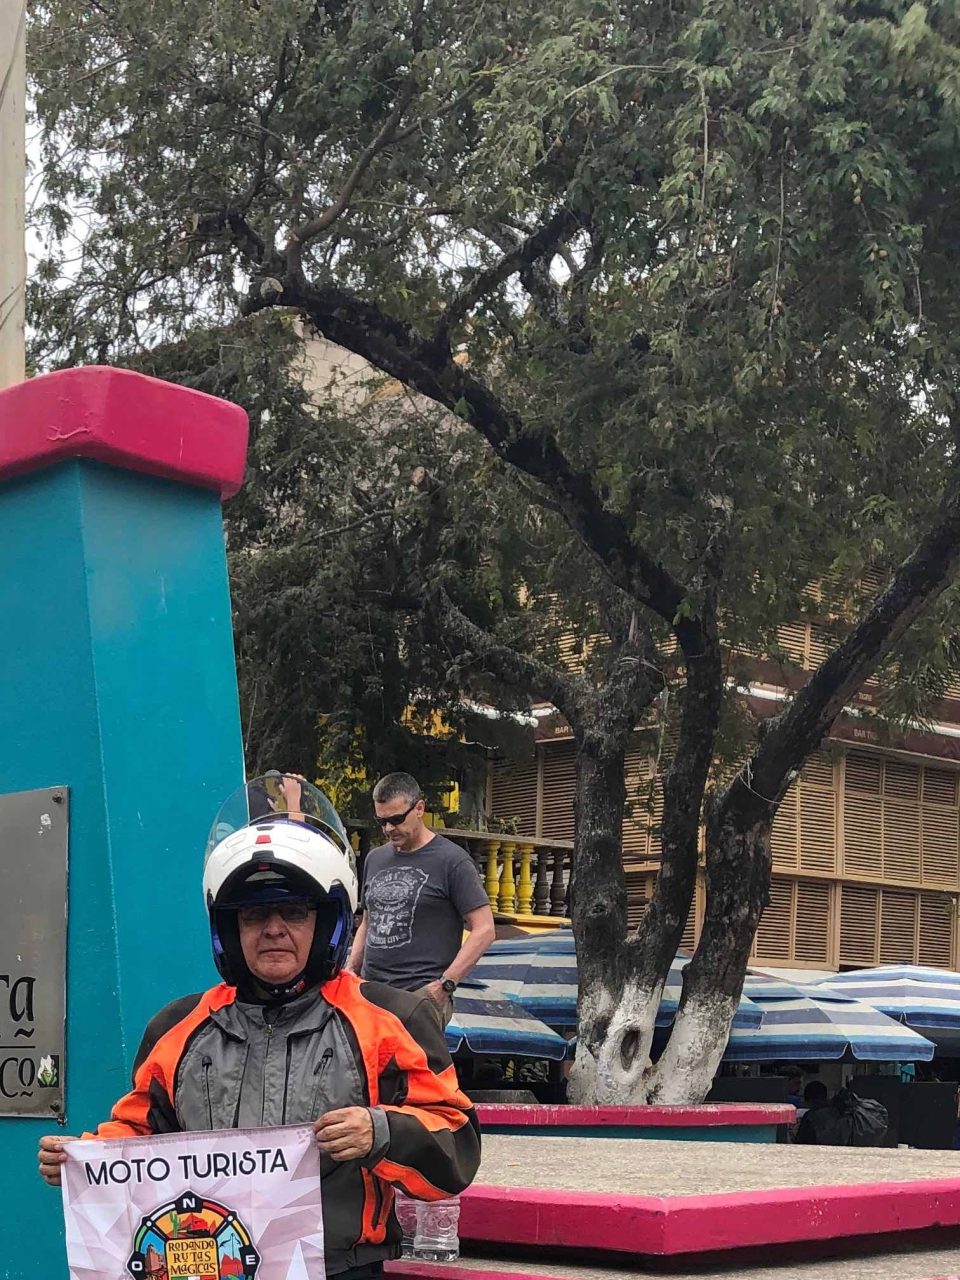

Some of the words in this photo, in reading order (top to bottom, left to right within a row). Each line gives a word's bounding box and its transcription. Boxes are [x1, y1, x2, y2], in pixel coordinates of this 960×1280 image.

[84, 1156, 171, 1186] MOTO
[177, 1148, 289, 1180] TURISTA
[182, 1197, 196, 1209] N
[245, 1255, 256, 1265] E
[131, 1261, 143, 1271] O
